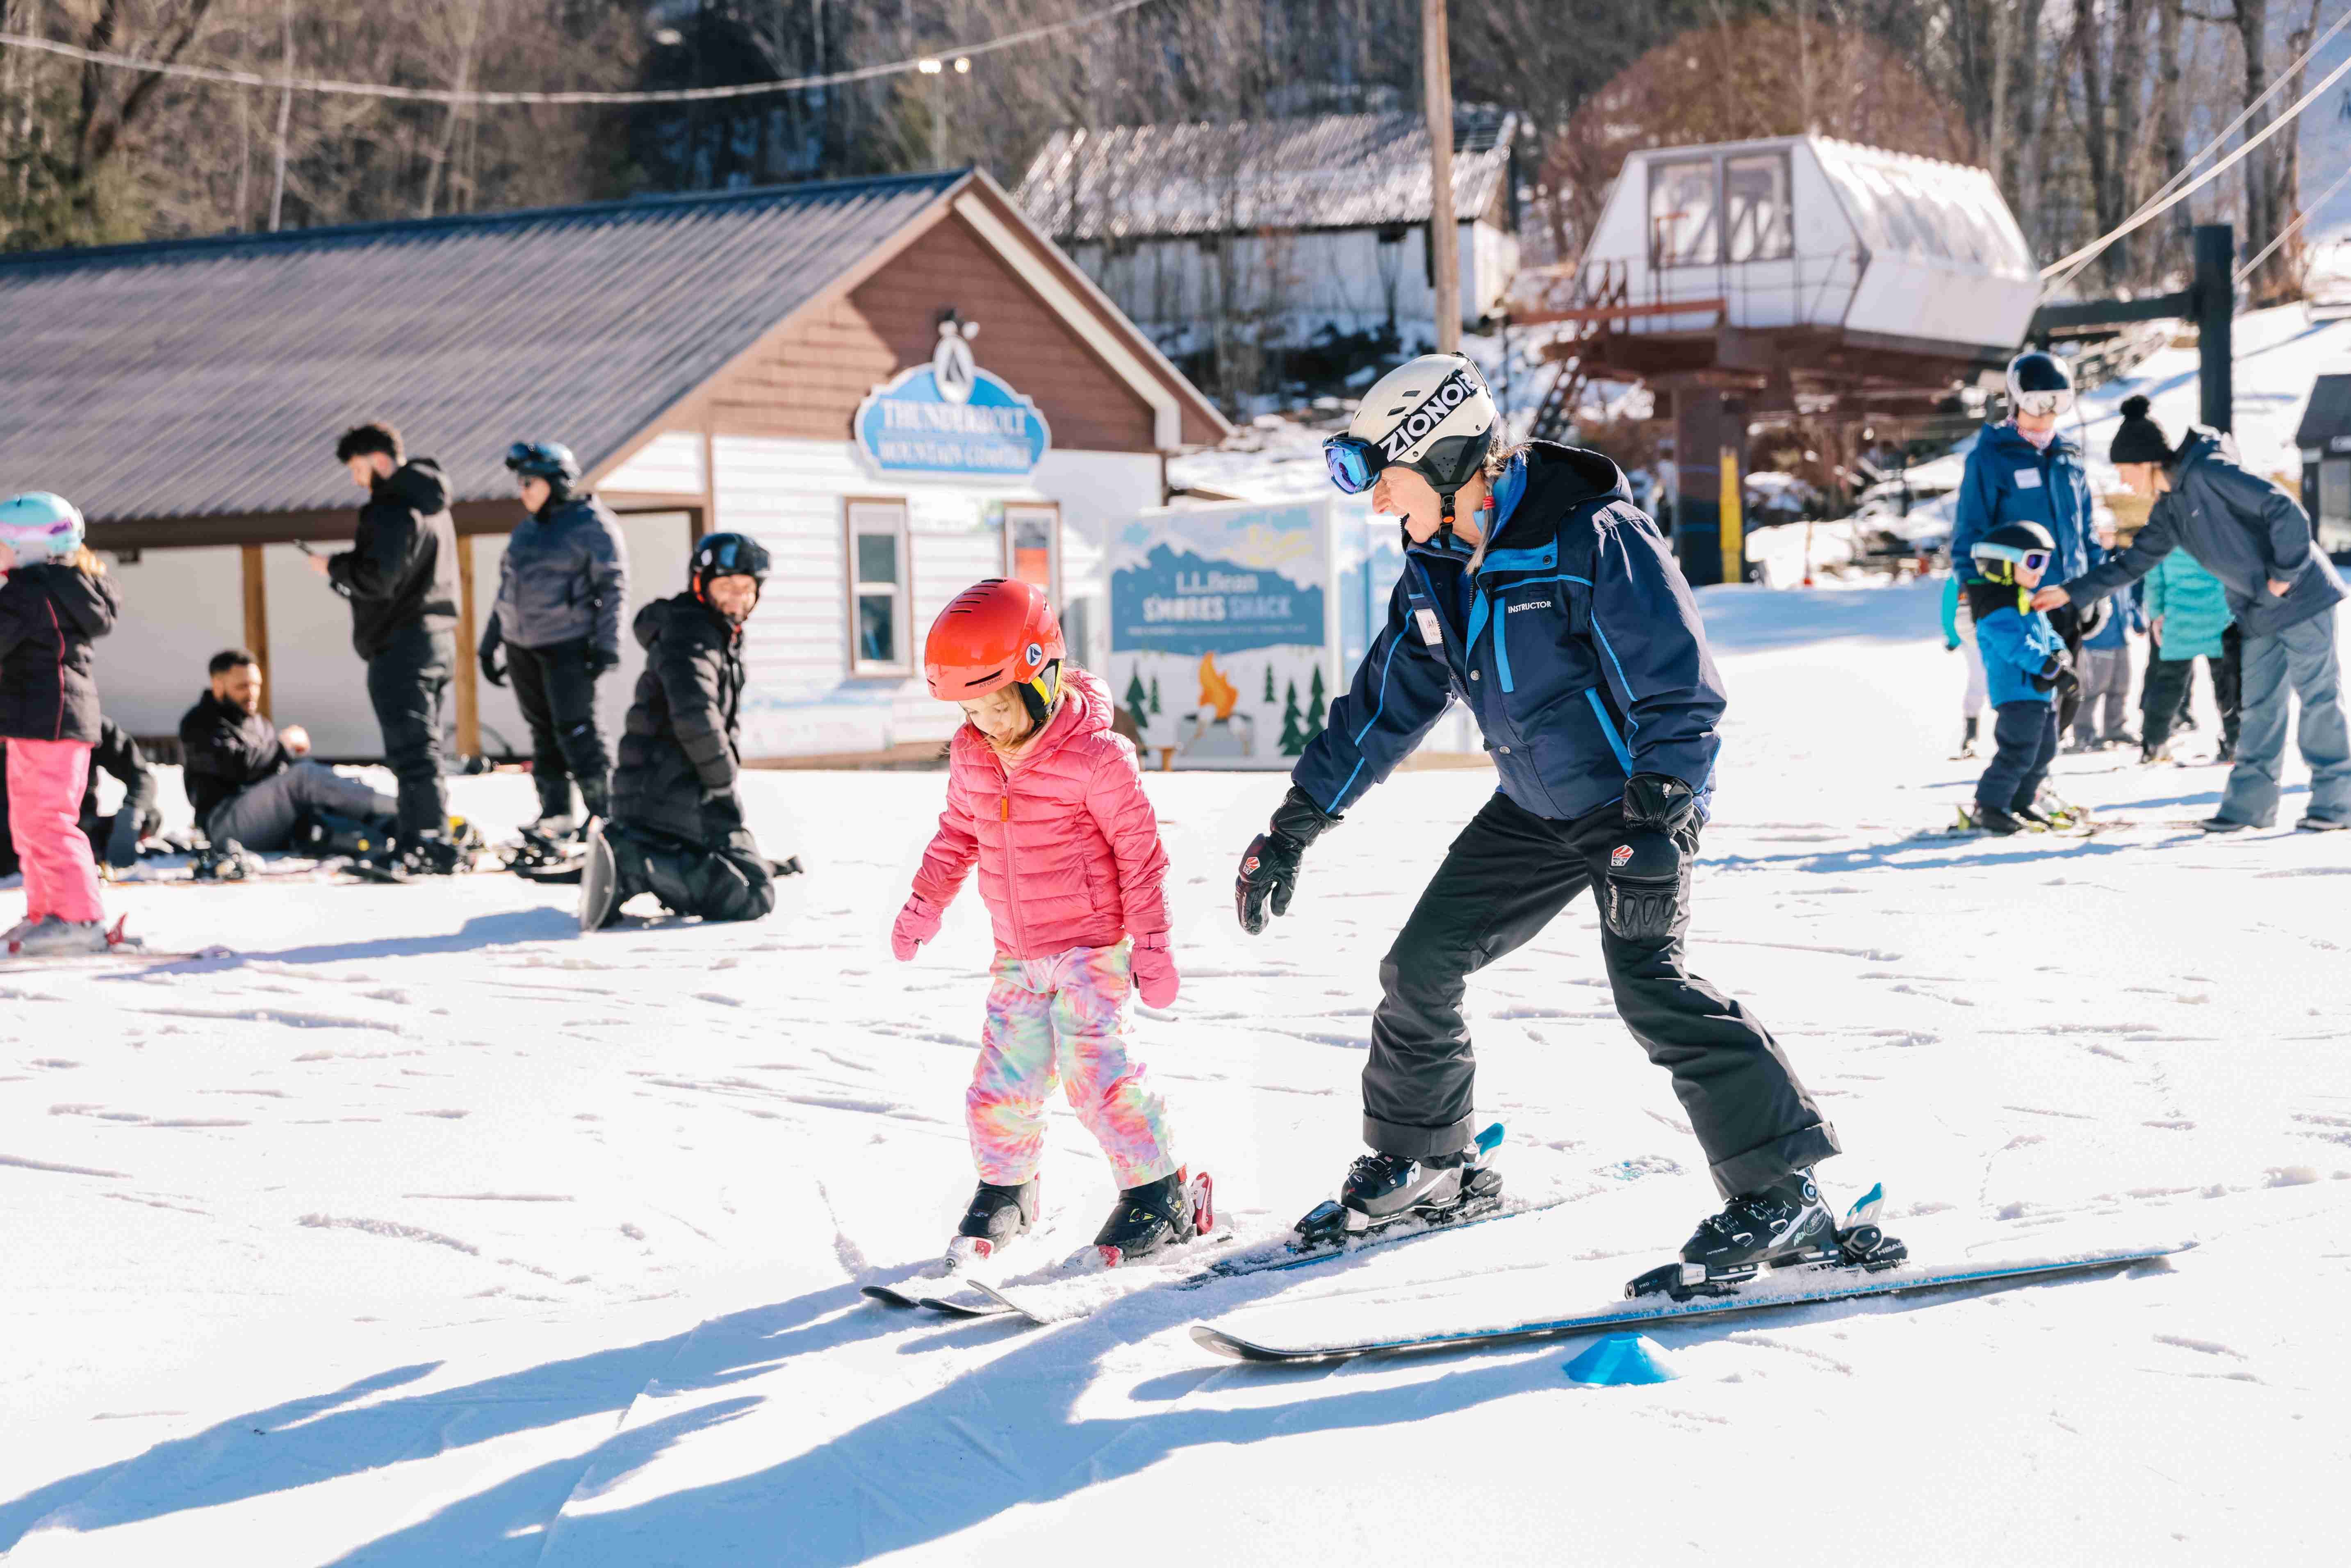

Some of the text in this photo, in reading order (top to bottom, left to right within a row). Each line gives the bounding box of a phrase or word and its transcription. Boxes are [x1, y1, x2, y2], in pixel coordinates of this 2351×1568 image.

[1378, 373, 1478, 462] ZIONOR
[1508, 601, 1551, 613] INSTRUCTOR
[979, 676, 1003, 688] ATOMIC
